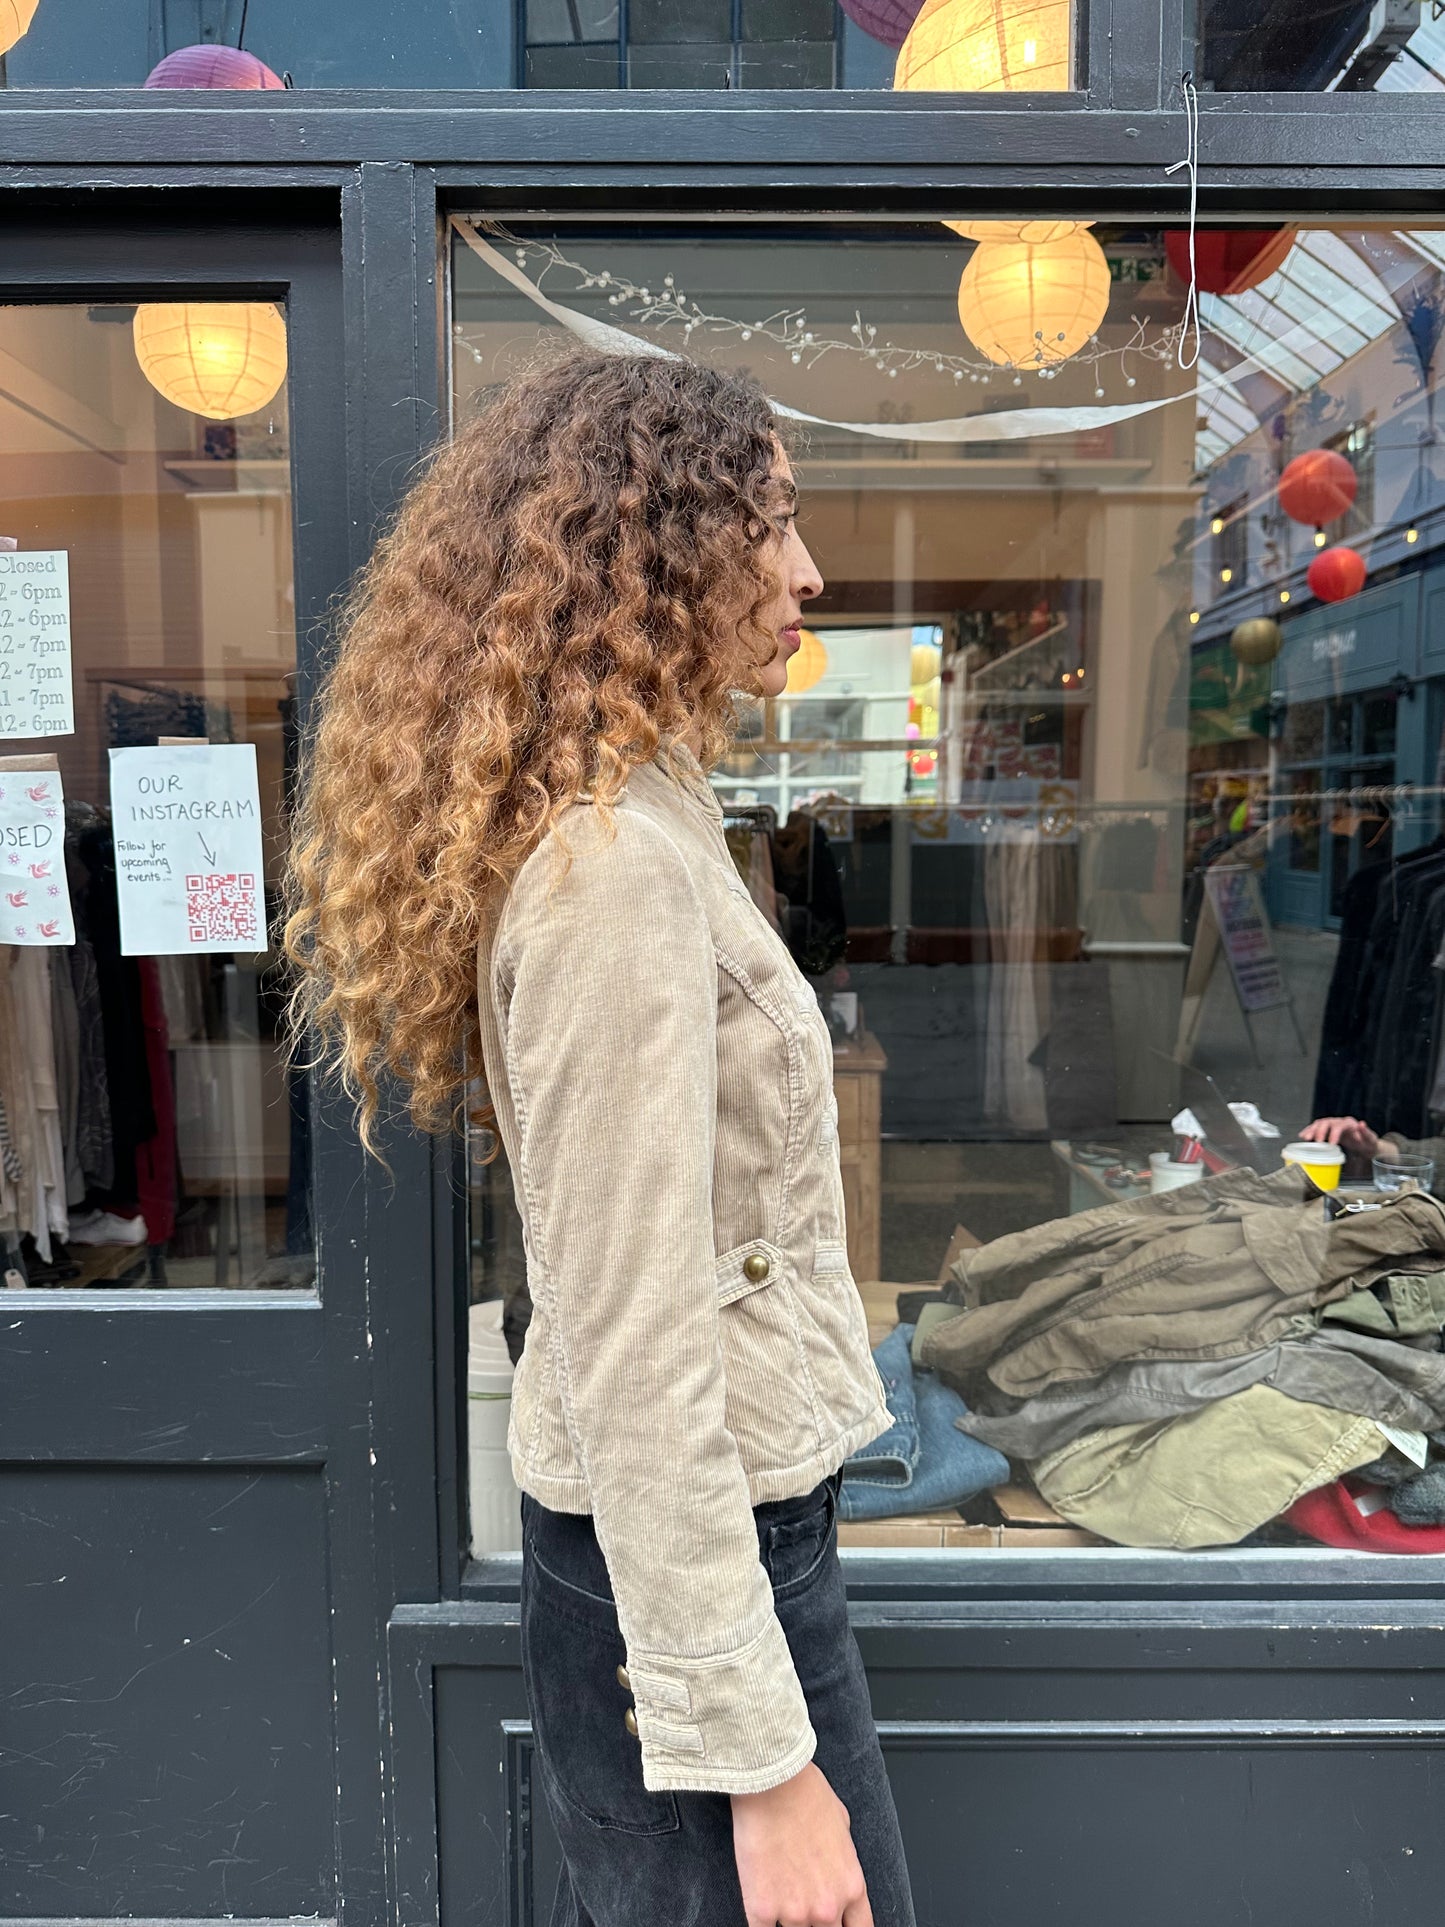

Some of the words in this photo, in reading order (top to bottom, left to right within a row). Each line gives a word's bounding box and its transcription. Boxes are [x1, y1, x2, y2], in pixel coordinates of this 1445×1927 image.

[22, 582, 62, 604] 6pm
[29, 609, 67, 631] 6pm
[30, 635, 67, 657] 7pm
[27, 663, 63, 684] 7pm
[30, 689, 65, 710] 7pm
[32, 714, 68, 735] 6pm
[138, 774, 183, 794] OUR
[131, 799, 255, 821] INSTAGRAM
[117, 840, 146, 852] Follow
[150, 840, 166, 859] for
[121, 857, 172, 874] upcoming
